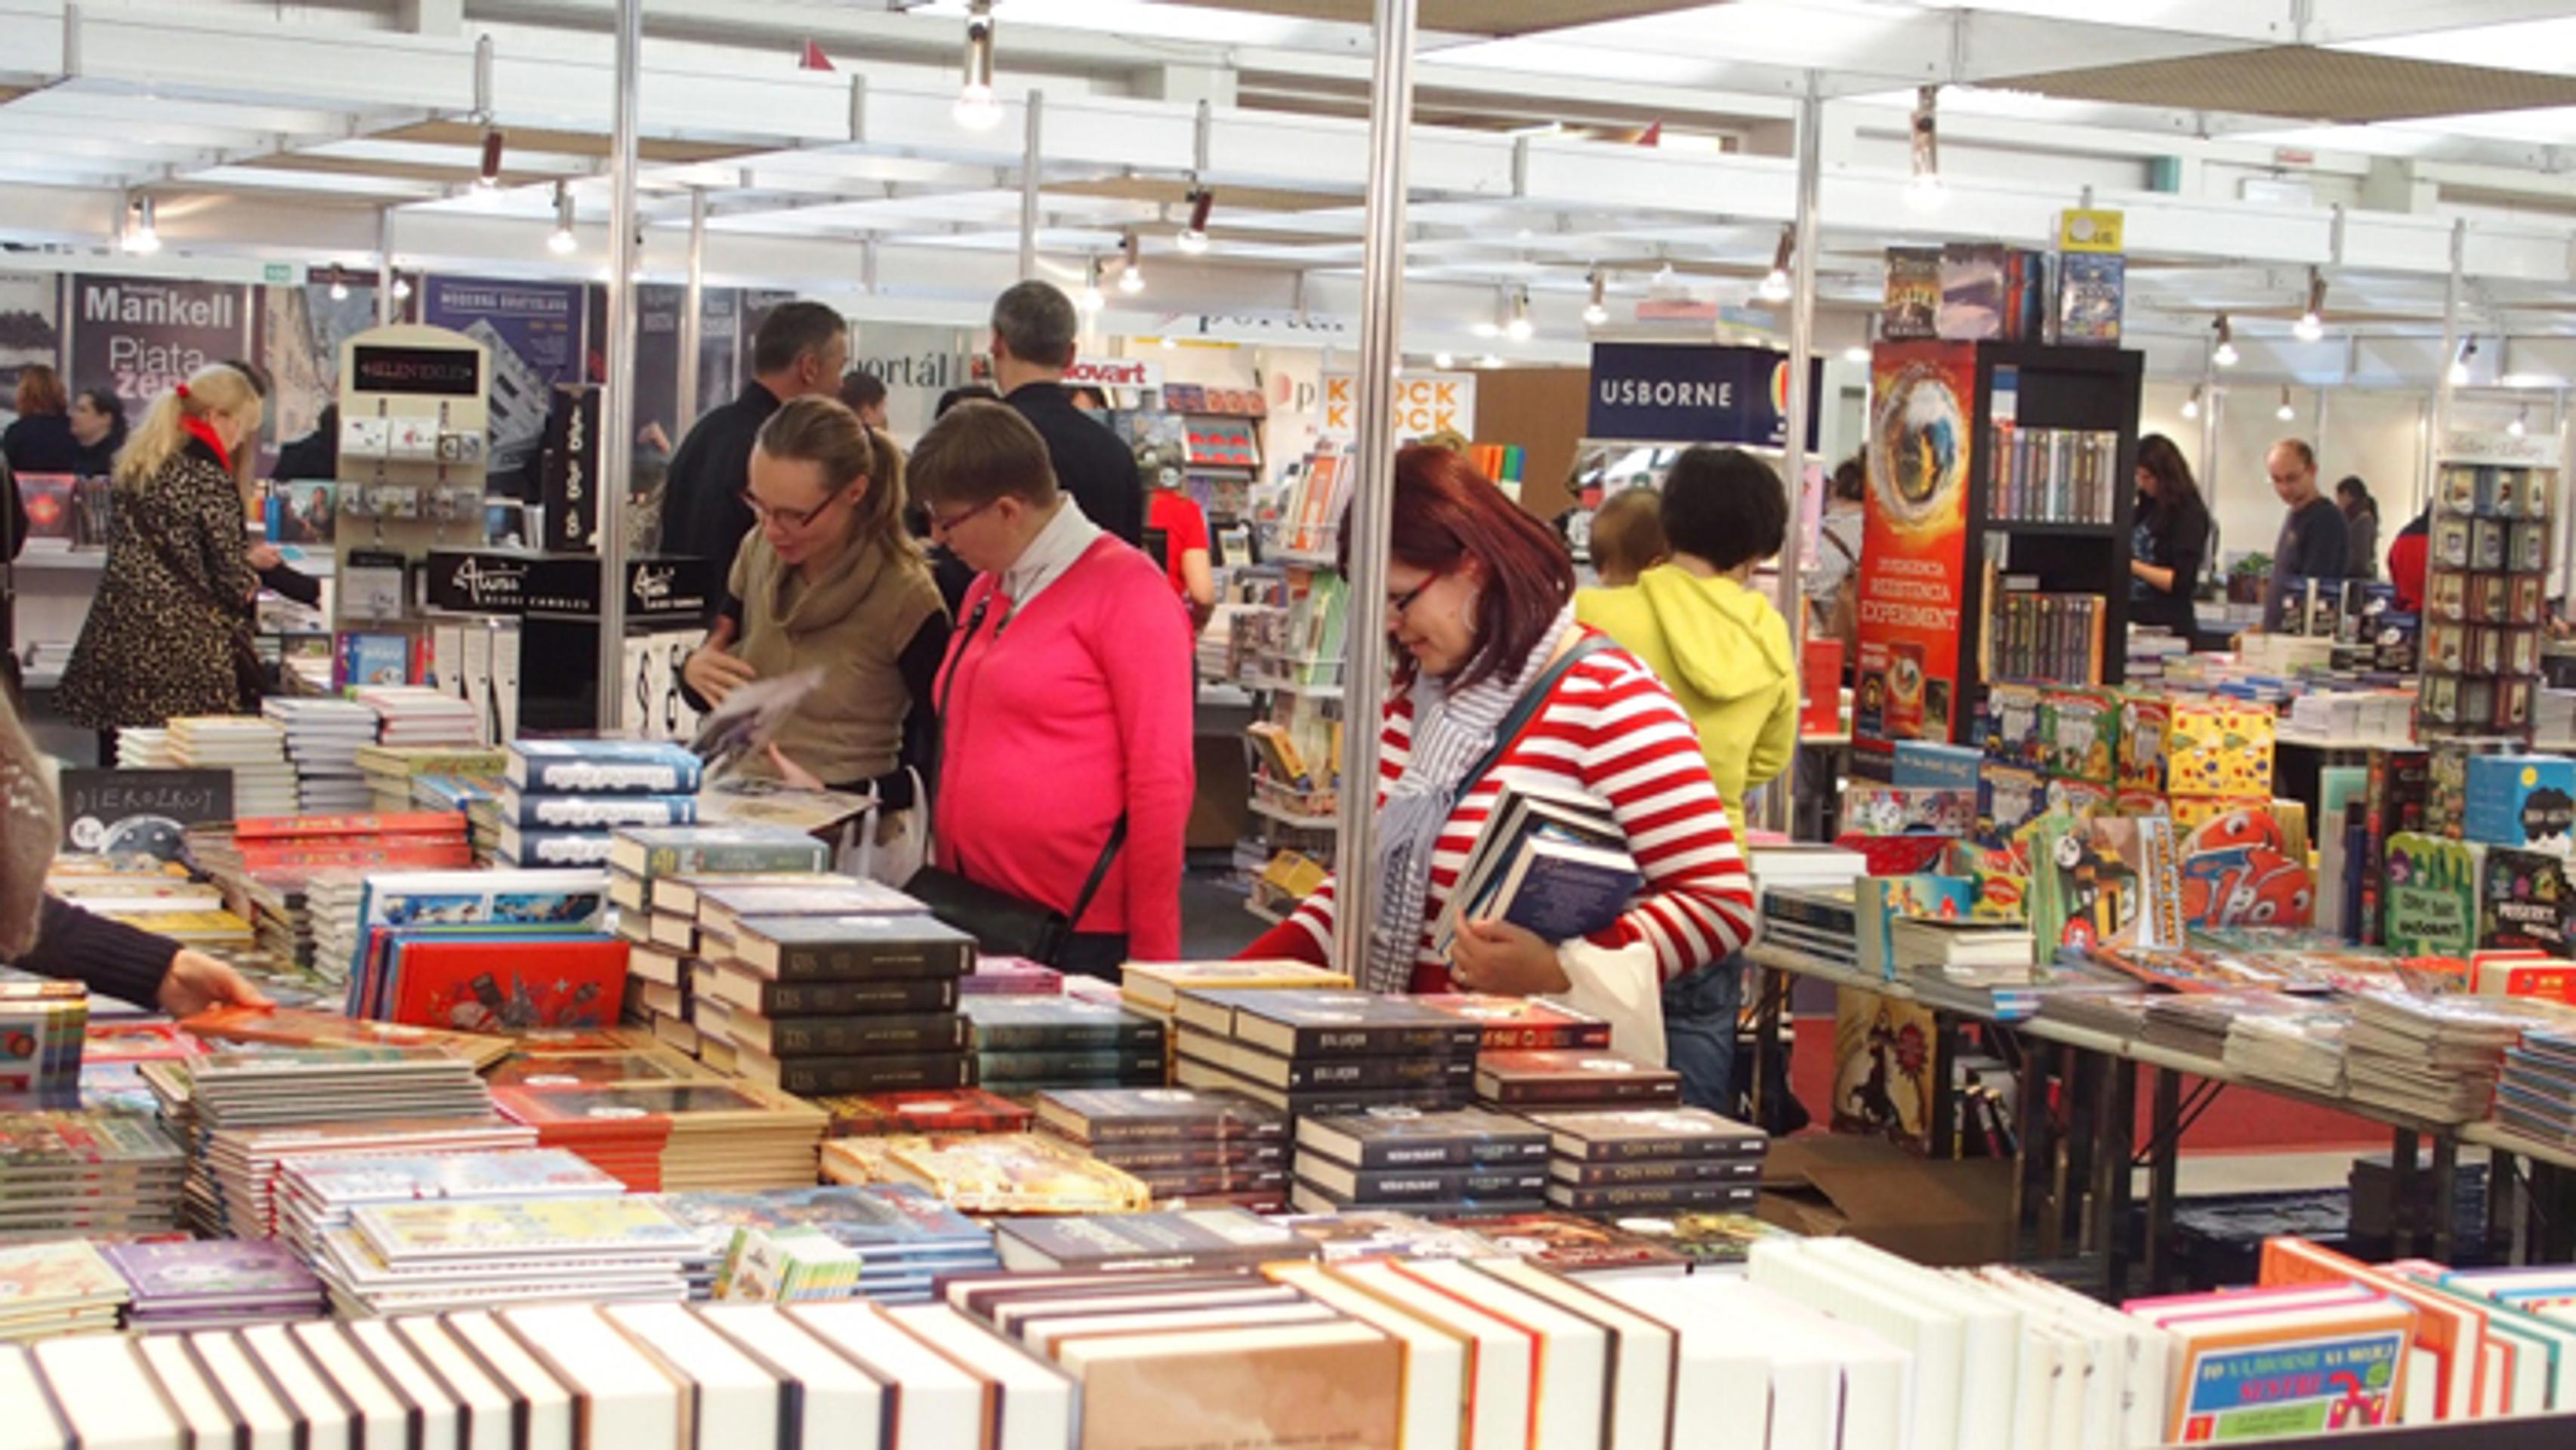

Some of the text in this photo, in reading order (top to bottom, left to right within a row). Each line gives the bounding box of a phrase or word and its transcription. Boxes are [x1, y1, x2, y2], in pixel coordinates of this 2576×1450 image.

[85, 286, 233, 328] Mankell
[110, 337, 204, 375] Piata
[856, 352, 947, 387] ortál
[1600, 381, 1732, 407] USBORNE
[1862, 600, 1959, 631] EXPERIMENT
